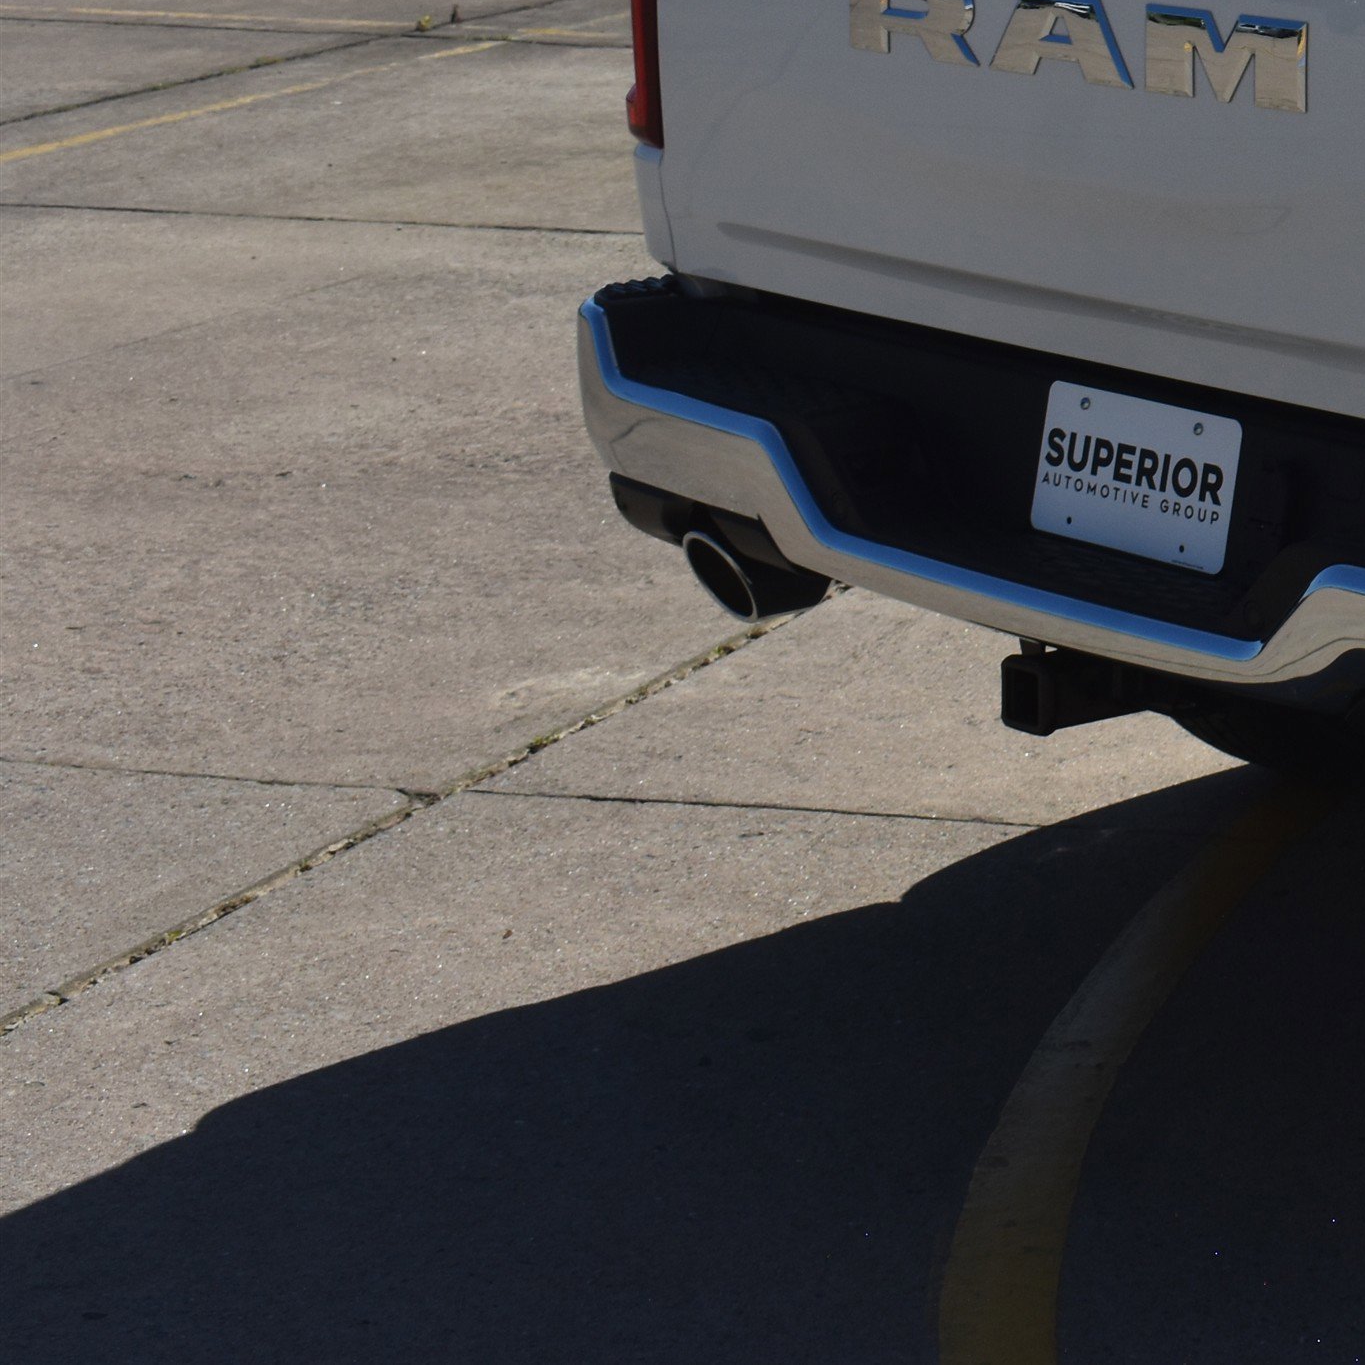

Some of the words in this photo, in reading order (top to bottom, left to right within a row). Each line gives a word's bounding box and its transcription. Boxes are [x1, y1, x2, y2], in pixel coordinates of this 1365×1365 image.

[1041, 471, 1150, 509] AUTOMOTIVE
[1160, 499, 1220, 525] GROUP
[1044, 427, 1224, 507] SUPERIOR
